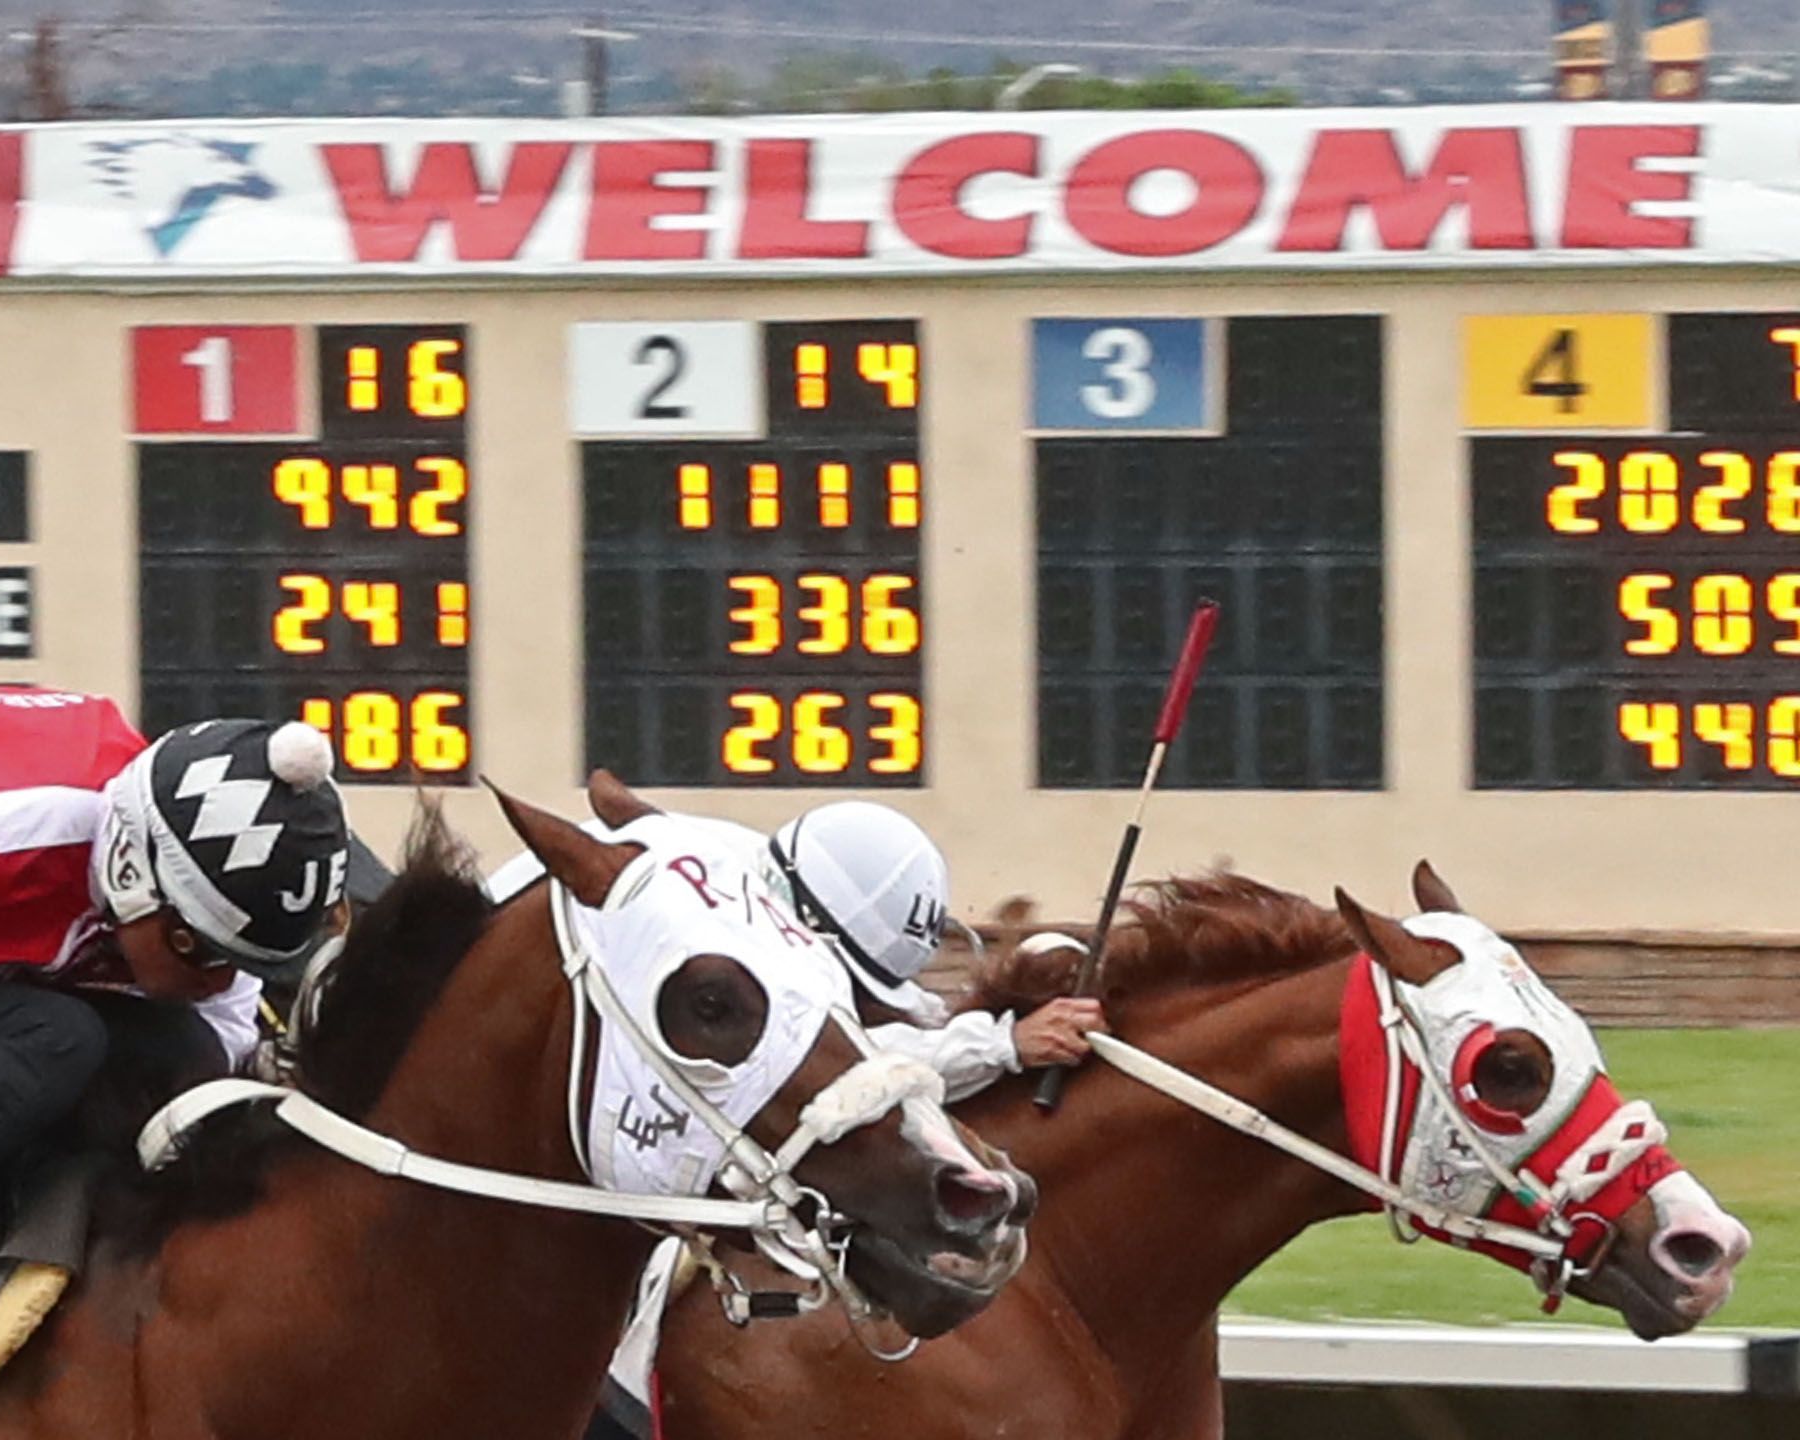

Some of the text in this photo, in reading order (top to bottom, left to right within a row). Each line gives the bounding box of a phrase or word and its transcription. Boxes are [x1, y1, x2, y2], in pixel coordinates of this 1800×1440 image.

[318, 124, 1702, 263] WELCOME
[183, 336, 235, 424] 1
[346, 338, 470, 419] 16
[633, 334, 691, 420] 2
[794, 341, 923, 409] 14
[1079, 327, 1158, 419] 3
[1521, 328, 1587, 415] 4
[271, 456, 471, 537] 942
[677, 461, 925, 530] 1111
[271, 573, 473, 654] 241
[728, 573, 925, 655] 336
[720, 690, 926, 774] 263
